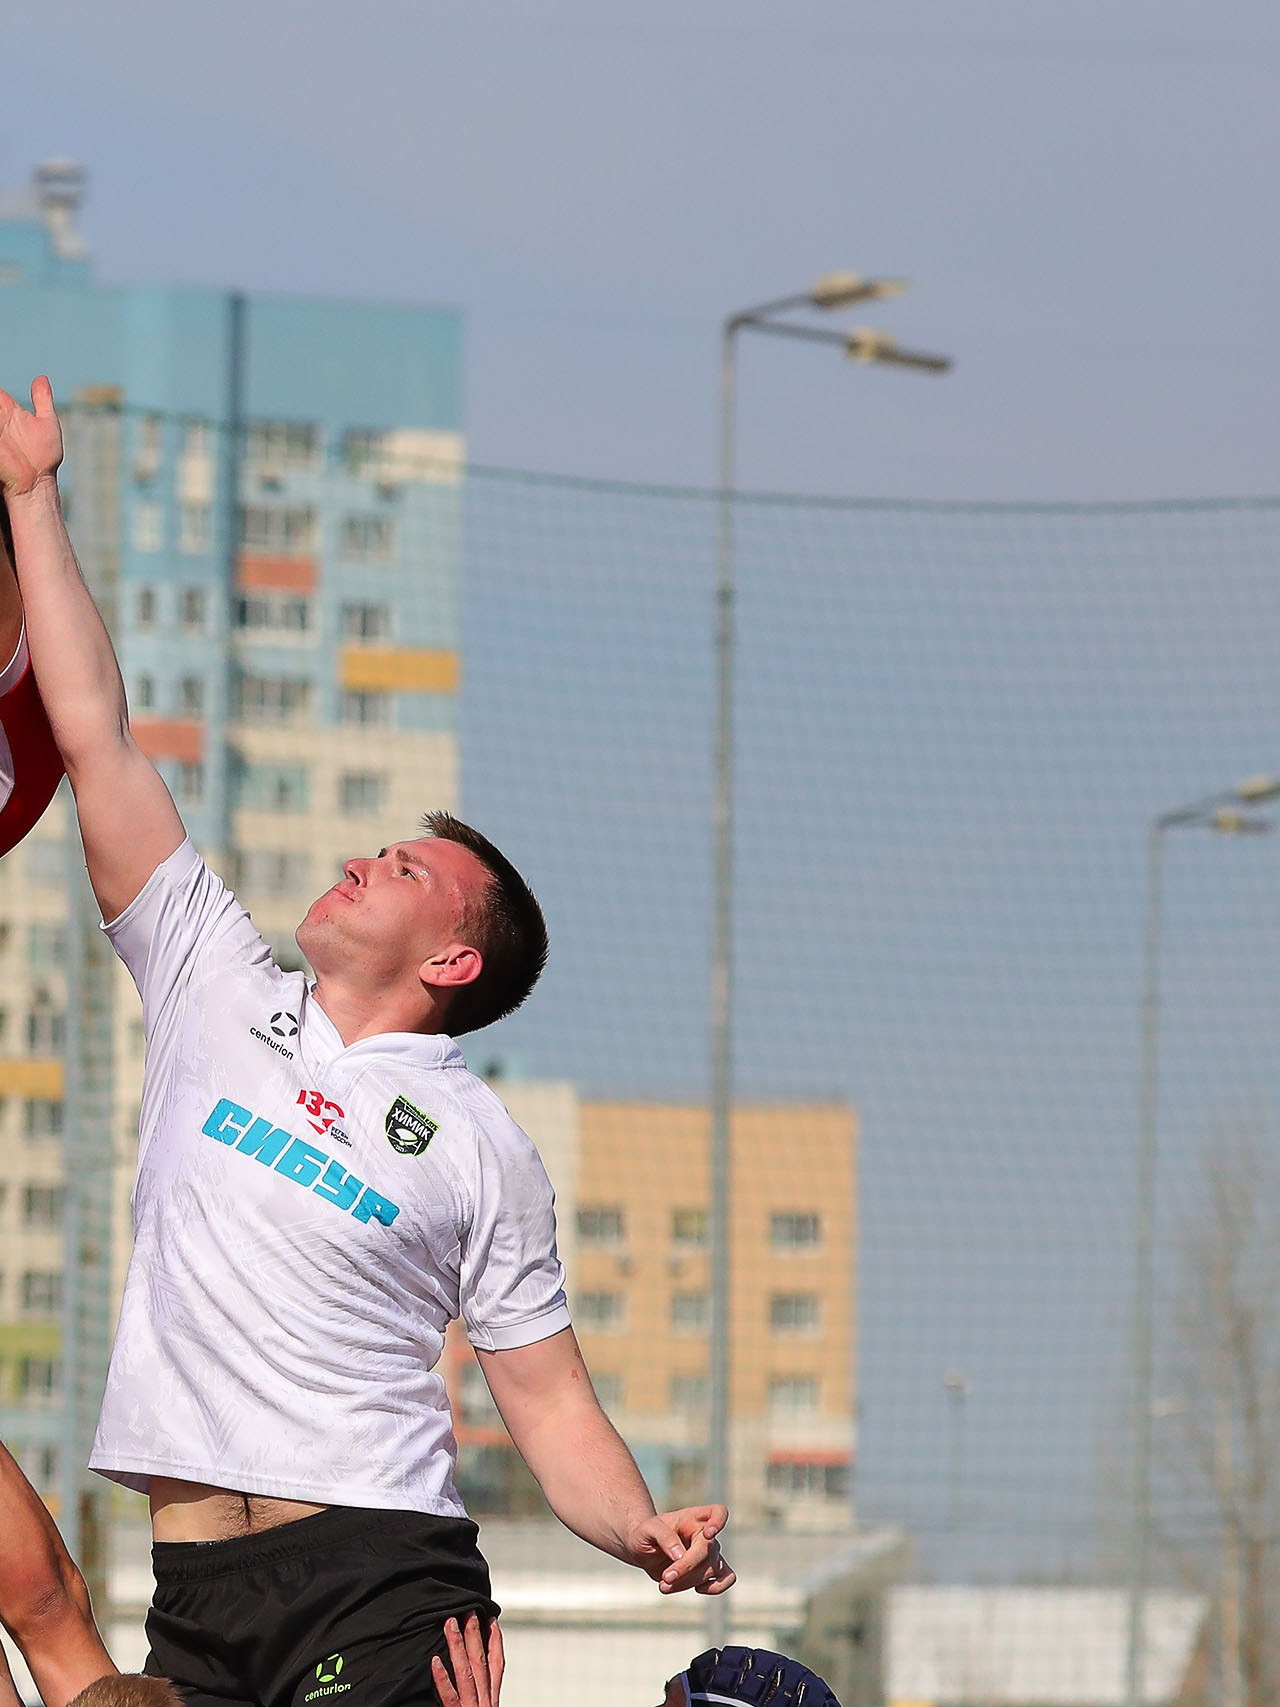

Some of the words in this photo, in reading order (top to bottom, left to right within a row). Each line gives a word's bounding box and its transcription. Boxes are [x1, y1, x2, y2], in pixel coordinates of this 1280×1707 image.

[250, 1026, 294, 1061] centurion
[391, 1107, 431, 1140] ХИМИК
[201, 1098, 401, 1227] СИБУР
[304, 1683, 351, 1702] centurion
